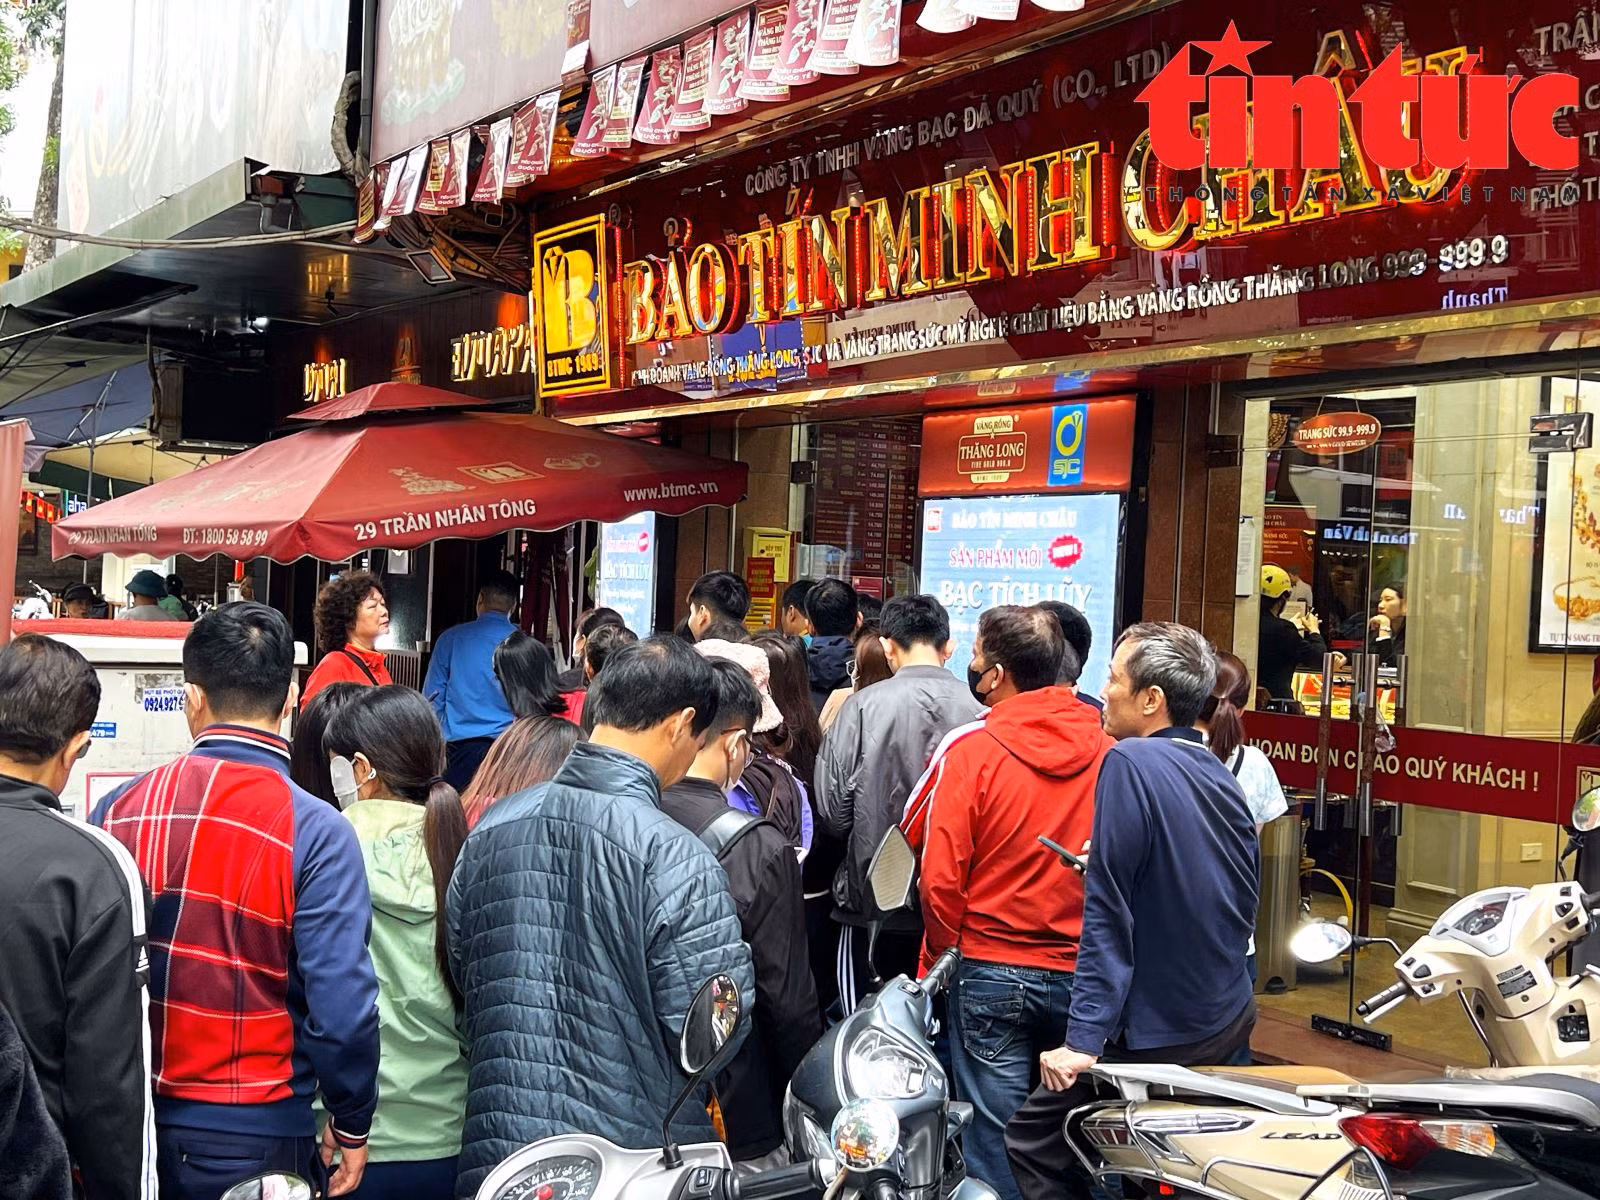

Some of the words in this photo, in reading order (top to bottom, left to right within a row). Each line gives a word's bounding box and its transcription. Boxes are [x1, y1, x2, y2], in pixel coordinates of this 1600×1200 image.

[745, 164, 788, 196] CÔNG
[864, 125, 913, 161] VÀNG
[917, 112, 958, 149] BẠC
[997, 78, 1043, 122] QUÝ
[624, 217, 727, 345] BẢO
[738, 187, 851, 325] TÍN
[863, 142, 1101, 302] MINH
[825, 336, 842, 361] VÀ
[842, 333, 876, 359] VÀNG
[876, 328, 918, 356] TRANG
[918, 320, 944, 349] SỨC
[1136, 282, 1185, 317] VÀNG
[1242, 263, 1315, 300] THĂNG
[1318, 254, 1379, 290] LONG
[959, 442, 994, 460] THĂNG
[996, 441, 1024, 459] LONG
[1299, 427, 1323, 441] TRANG
[624, 481, 719, 502] www.btmc.vn
[201, 527, 225, 545] 1800
[226, 528, 238, 545] 58
[239, 528, 253, 545] 58
[254, 528, 268, 546] 99
[353, 520, 377, 541] 29
[380, 510, 432, 537] TRẦN
[435, 503, 487, 529] NHÂN
[488, 497, 537, 520] TÔNG
[939, 579, 983, 615] BẠC
[1405, 755, 1447, 781] QUÝ
[1452, 761, 1526, 790] KHÁCH
